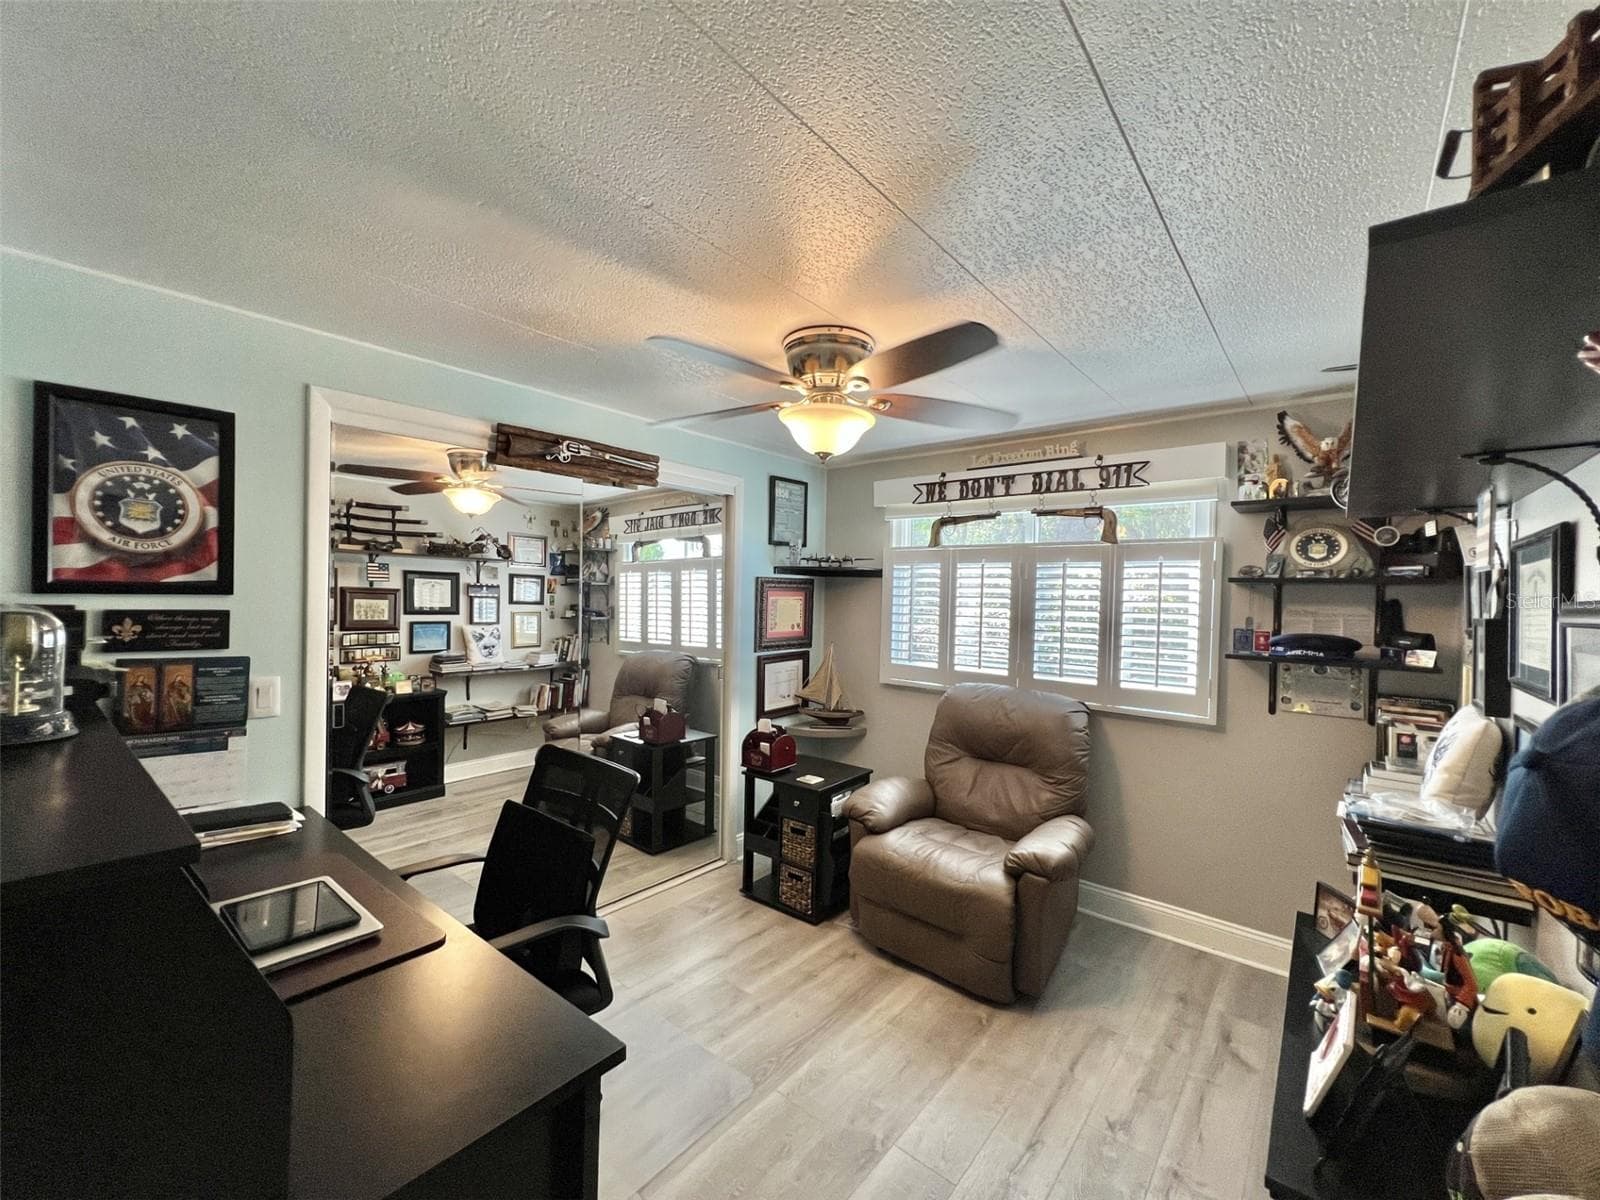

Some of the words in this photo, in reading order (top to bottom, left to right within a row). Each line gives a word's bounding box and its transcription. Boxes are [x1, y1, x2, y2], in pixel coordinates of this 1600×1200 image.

[1044, 440, 1080, 456] Ring
[98, 466, 143, 478] UNITED
[146, 468, 184, 486] STATES
[926, 483, 948, 501] WE
[959, 475, 1016, 498] DON'T
[1032, 468, 1085, 494] DIAL
[1100, 463, 1133, 488] 911
[108, 536, 131, 548] AIR
[134, 539, 173, 550] FORCE
